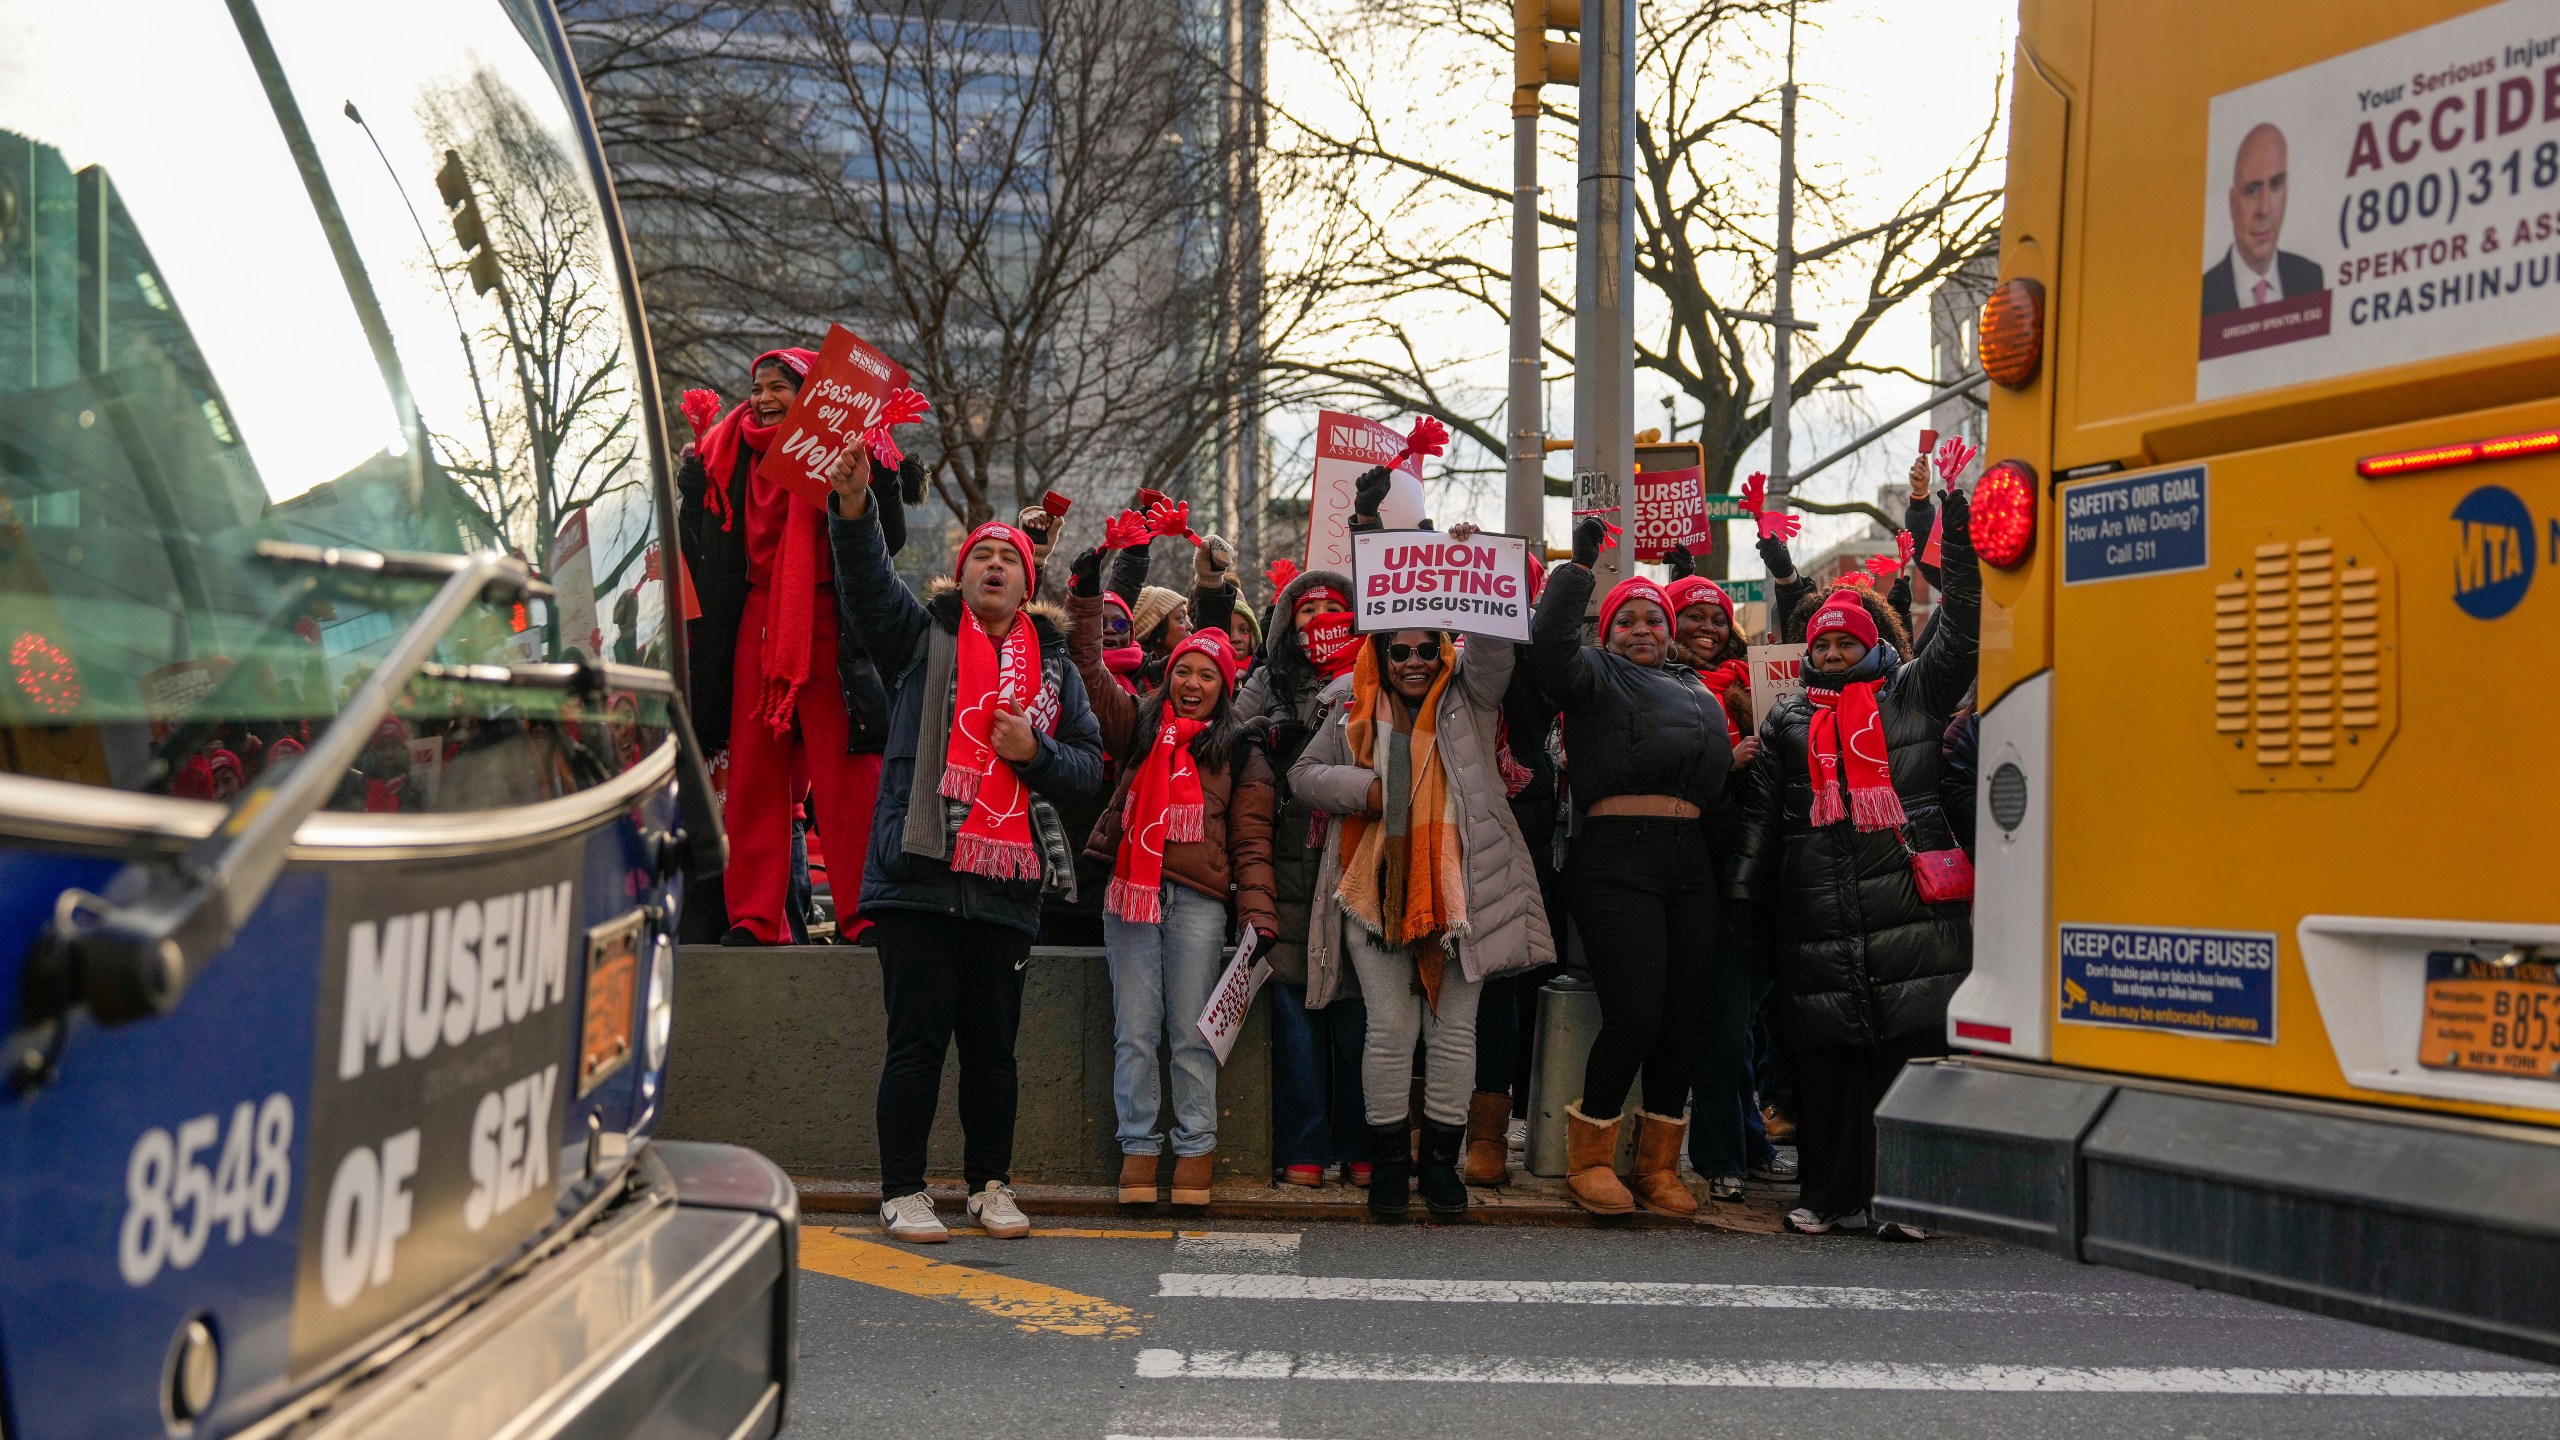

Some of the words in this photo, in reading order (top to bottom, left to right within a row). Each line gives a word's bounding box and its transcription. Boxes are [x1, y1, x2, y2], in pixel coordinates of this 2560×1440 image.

[2358, 84, 2406, 112] Your
[2412, 56, 2496, 97] Serious
[2338, 233, 2468, 287] SPEKTOR
[2481, 226, 2499, 254] &
[850, 349, 891, 382] NURSES
[852, 344, 892, 372] ASSOCIATION
[1330, 425, 1406, 459] NURS
[1363, 423, 1381, 435] New
[1382, 429, 1397, 442] York
[1634, 497, 1703, 520] ESERVE
[2069, 488, 2128, 519] SAFETY'S
[2131, 483, 2160, 508] OUR
[2163, 477, 2199, 503] GOAL
[1634, 518, 1692, 537] GOOD
[2068, 523, 2097, 543] How
[2100, 519, 2123, 538] Are
[2125, 514, 2147, 534] We
[2150, 505, 2199, 532] Doing?
[1634, 538, 1657, 548] LTH
[1662, 532, 1706, 548] BENEFITS
[2106, 543, 2132, 565] Call
[2135, 540, 2156, 561] 511
[1384, 544, 1497, 571] UNION
[2451, 519, 2524, 595] MTA
[1367, 569, 1517, 598] BUSTING
[1366, 601, 1386, 615] IS
[1392, 597, 1518, 617] DISGUSTING
[2063, 932, 2110, 958] KEEP
[2111, 935, 2172, 962] CLEAR
[2174, 938, 2201, 965] OF
[2204, 940, 2271, 970] BUSES
[338, 881, 573, 1081] MUSEUM
[2086, 963, 2108, 978] Don't
[2110, 964, 2138, 980] double
[2139, 968, 2159, 983] park
[2161, 971, 2169, 982] or
[2171, 967, 2196, 984] block
[2197, 970, 2212, 985] bus
[2113, 981, 2128, 994] bus
[2158, 986, 2166, 997] or
[2167, 984, 2187, 1000] bike
[2188, 986, 2213, 1002] lanes
[2494, 990, 2511, 1017] B
[2090, 1001, 2117, 1018] Rules
[2118, 1005, 2140, 1024] may
[2140, 1005, 2154, 1021] be
[2155, 1008, 2201, 1026] enforced
[2202, 1011, 2216, 1029] by
[2217, 1015, 2258, 1032] camera
[2491, 1021, 2508, 1048] B
[120, 1091, 293, 1287] 8548
[321, 1127, 422, 1309] OF
[463, 1064, 559, 1232] SEX
